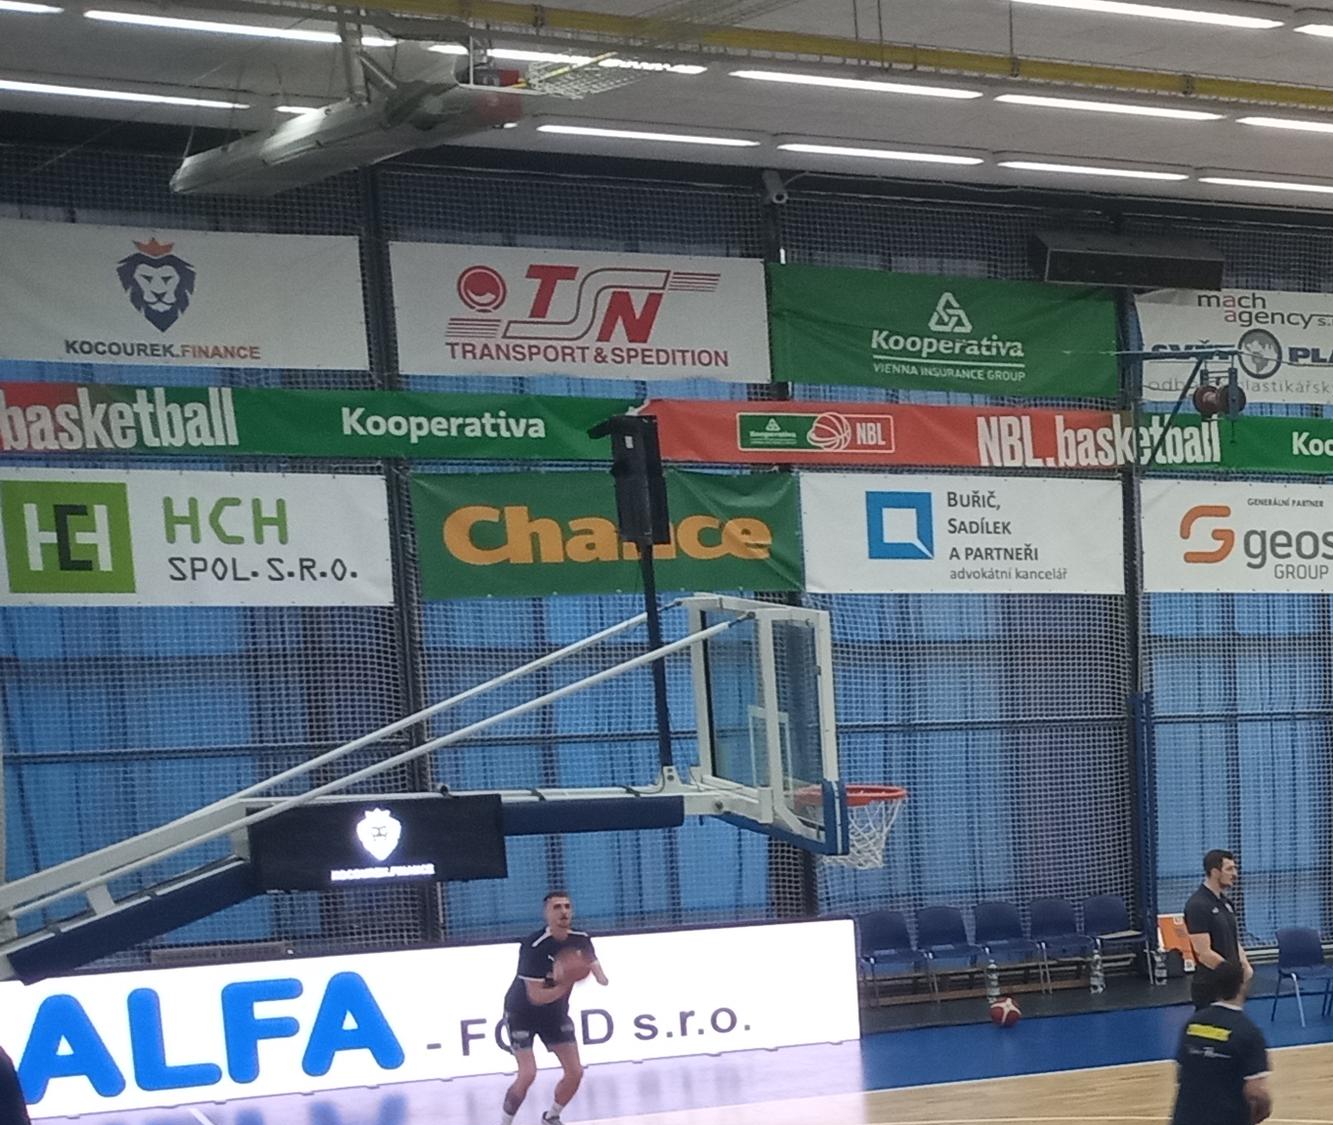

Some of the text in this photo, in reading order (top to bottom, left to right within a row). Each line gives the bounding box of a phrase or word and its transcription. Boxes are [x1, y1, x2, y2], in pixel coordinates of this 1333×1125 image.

[1197, 292, 1267, 310] mach
[1224, 308, 1314, 330] agency
[446, 341, 590, 364] TRANSPORT
[610, 347, 729, 367] SPEDITION
[871, 328, 1025, 359] Kooperativa
[873, 362, 1027, 381] VIENNA INSURANCE GROUP
[343, 407, 546, 443] Kooperativa
[856, 422, 886, 446] NBL
[947, 490, 1002, 511] BUŘIČ,
[163, 495, 289, 545] HCH
[947, 517, 1012, 536] SADÍLEK
[442, 505, 773, 563] Chace
[949, 544, 1039, 562] A PARTNEŘI
[168, 556, 359, 582] SPOL. S.R.O.
[949, 565, 1068, 580] advokátní kancelář
[1274, 563, 1329, 581] GROUP
[18, 971, 405, 1104] ALFA
[460, 1007, 615, 1057] FD
[634, 1002, 752, 1043] s.r.o.
